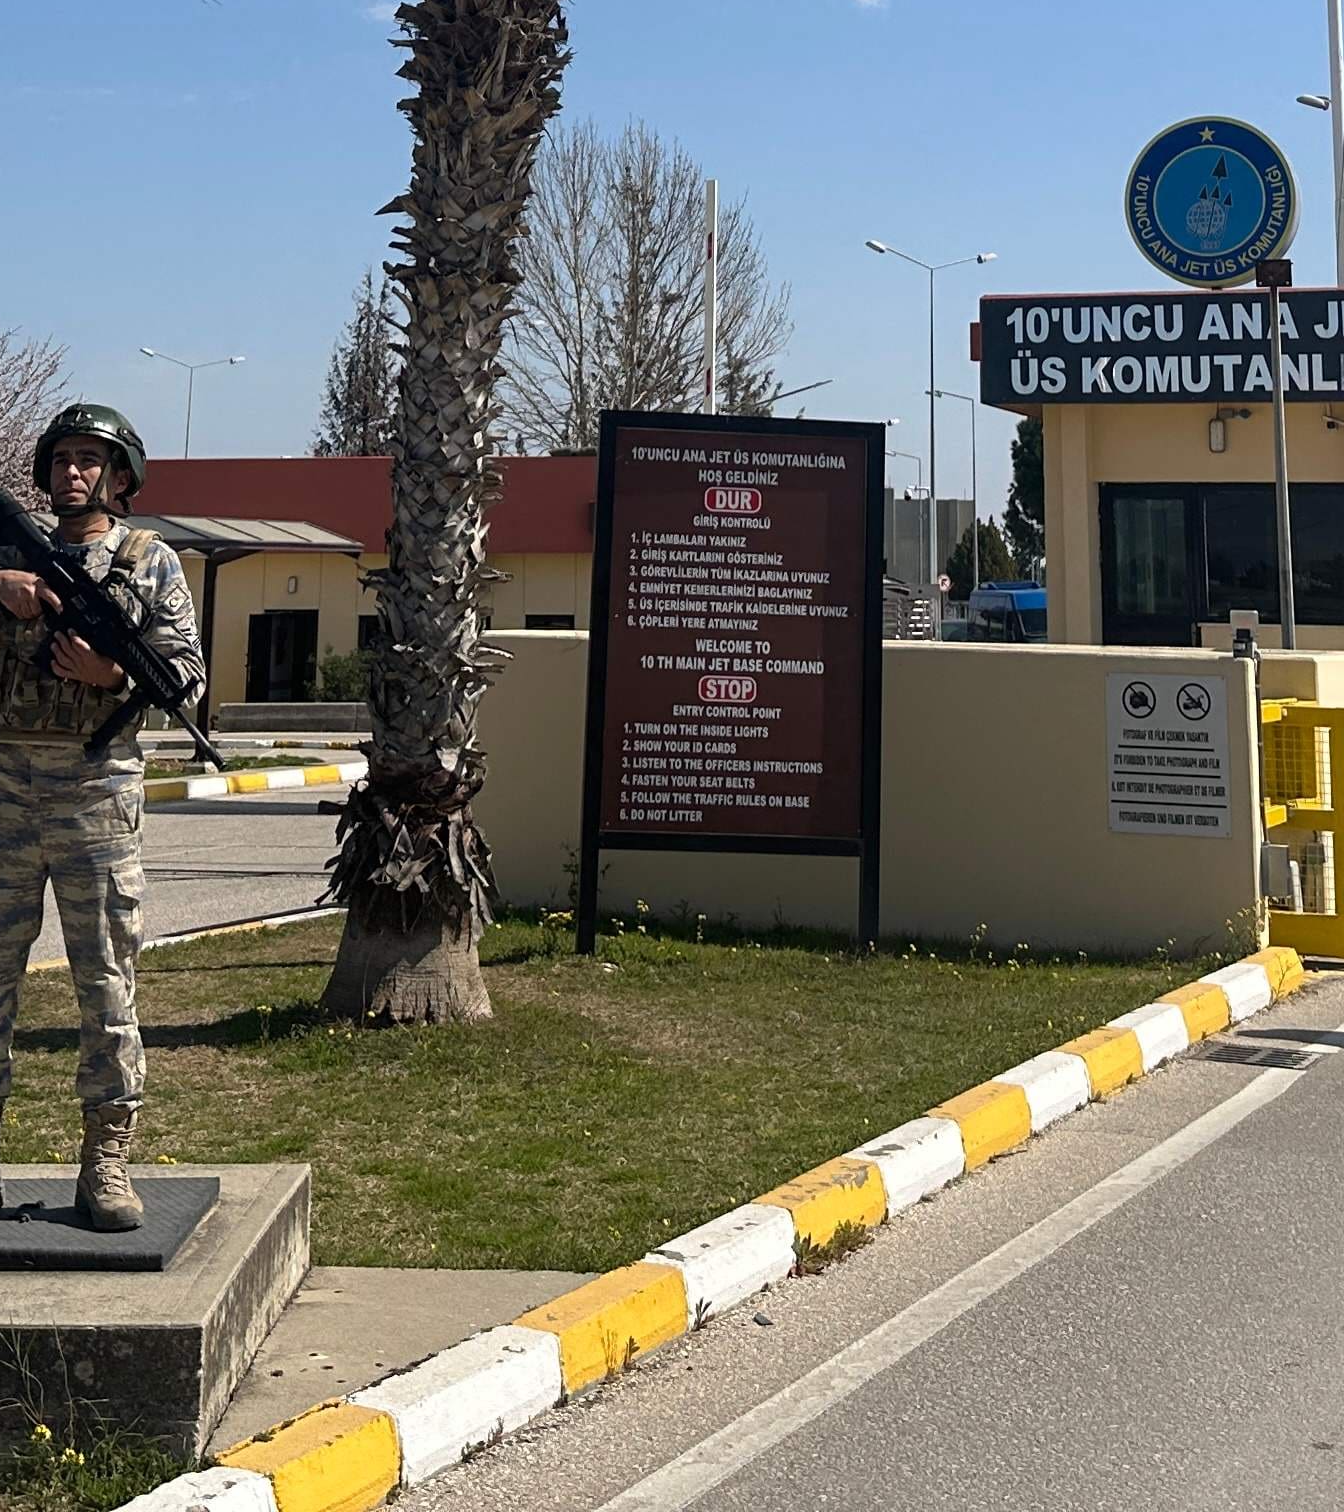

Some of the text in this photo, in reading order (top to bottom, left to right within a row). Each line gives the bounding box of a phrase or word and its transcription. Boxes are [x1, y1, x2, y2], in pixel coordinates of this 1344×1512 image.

[1134, 164, 1287, 276] 10'UNCU ANA JET ÜS KOMUTANLIĞI
[1006, 304, 1183, 344] 10'UNCU
[1198, 302, 1299, 341] ANA
[1011, 350, 1067, 393] ÜS
[632, 447, 846, 469] 10'UNCU ANA JET ÜS KOMUTANLIĞINA
[699, 470, 778, 485] HOŞ GELDİNİZ
[715, 491, 752, 509] DUR
[693, 515, 771, 529] GİRİŞ KONTROLÜ
[631, 531, 746, 547] 1. İÇ LAMBALARI YAKINIZ
[630, 547, 783, 565] 2. GİRİŞ KARTLARINI GÖSTERİNİZ
[630, 566, 830, 584] 3. GÖREVLİLERİN TÜM İKAZLARINA UYUNUZ
[629, 582, 637, 593] 4.
[640, 581, 681, 594] EMNİYET
[684, 584, 755, 597] KEMERLERİNİZİ
[628, 598, 848, 617] 5. ÜS İÇERİSİNDE TRAFİK KAİDELERİNE UYUNUZ
[628, 615, 758, 630] 6. ÇÖPLERİ YERE ATMAYINIZ
[696, 639, 770, 654] WELCOME TO
[641, 656, 824, 674] 10 TH MAIN JET BASE COMMAND
[706, 679, 753, 699] STOP
[673, 705, 781, 719] ENTRY CONTROL POINT
[624, 724, 768, 738] 1. TURN ON THE INSIDE LIGHTS
[623, 740, 736, 754] 2. SHOW YOUR ID CARDS
[622, 758, 823, 773] 3. LISTEN TO THE OFFICERS INSTRUCTIONS
[621, 775, 755, 789] 4. FASTEN YOUR SEAT BELTS
[621, 792, 809, 807] 5. FOLLOW THE TRAFFIC RULES ON BASE
[631, 809, 644, 820] DO
[647, 810, 667, 821] NOT
[670, 811, 702, 821] LITTER
